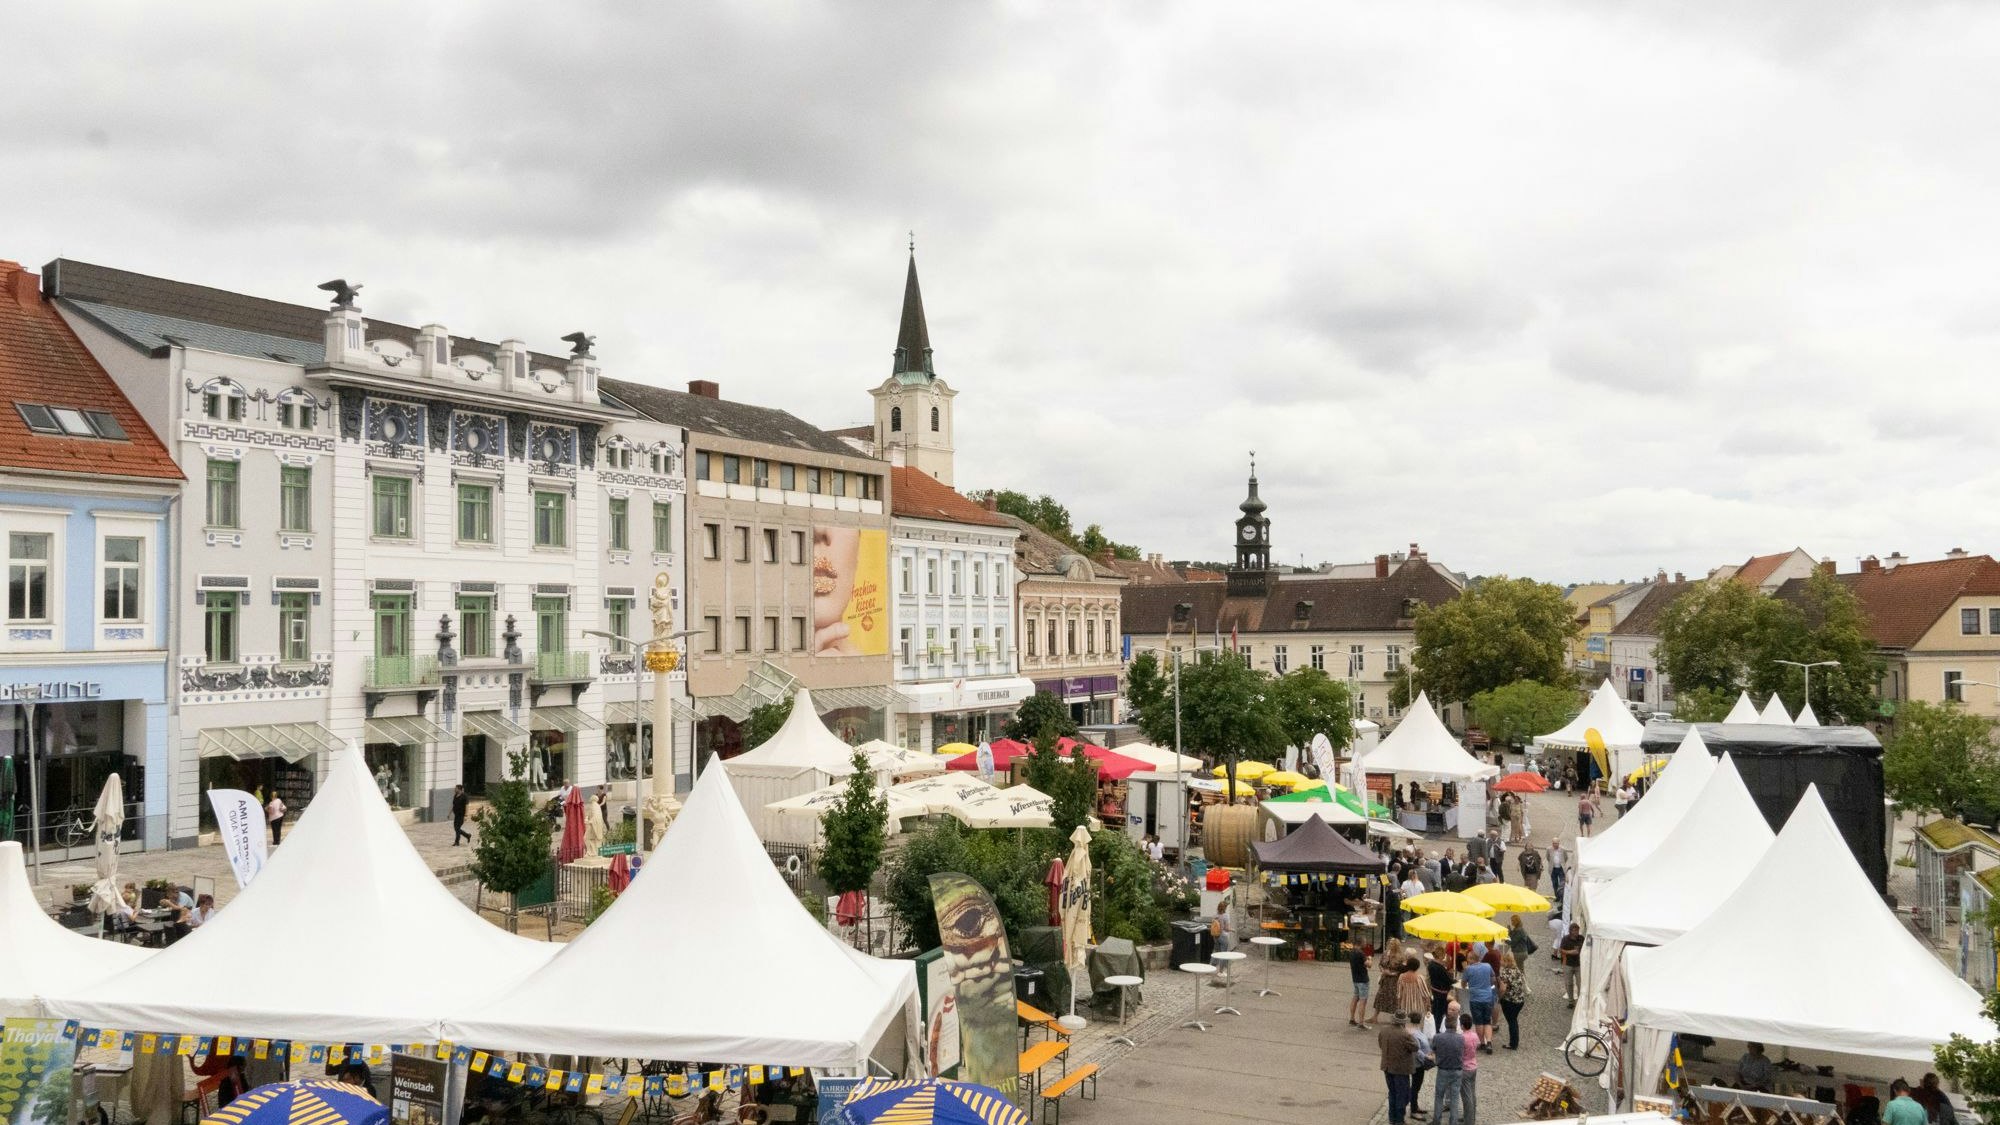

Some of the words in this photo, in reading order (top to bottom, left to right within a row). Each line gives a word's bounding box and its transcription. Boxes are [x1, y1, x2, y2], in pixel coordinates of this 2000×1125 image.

[1633, 670, 1642, 680] L
[394, 1076, 434, 1093] Weinstadt
[394, 1087, 412, 1100] Retz
